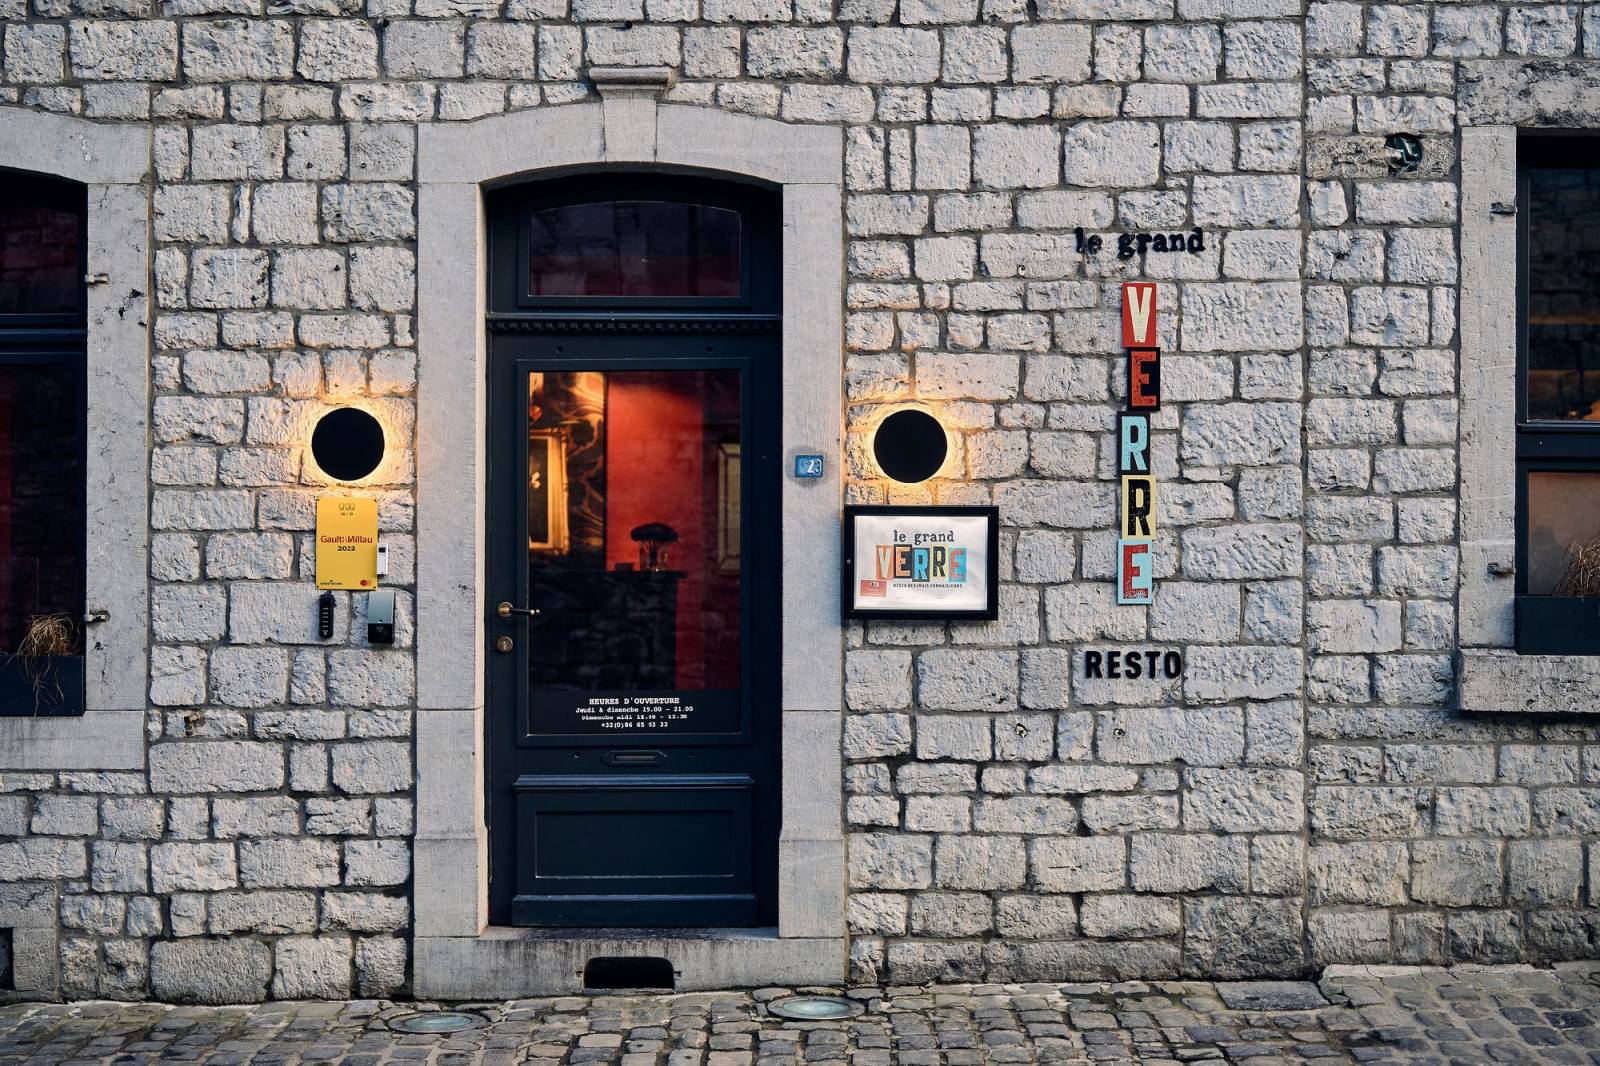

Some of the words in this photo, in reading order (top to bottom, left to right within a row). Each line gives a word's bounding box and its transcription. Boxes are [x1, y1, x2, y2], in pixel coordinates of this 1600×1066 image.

[1076, 227, 1103, 254] le
[1117, 227, 1206, 257] grand
[1121, 286, 1158, 600] VERRE
[893, 530, 906, 542] le
[914, 530, 955, 545] grand
[877, 545, 964, 581] VERRE
[1085, 650, 1181, 680] RESTO
[624, 697, 680, 705] D'OUVERTURE
